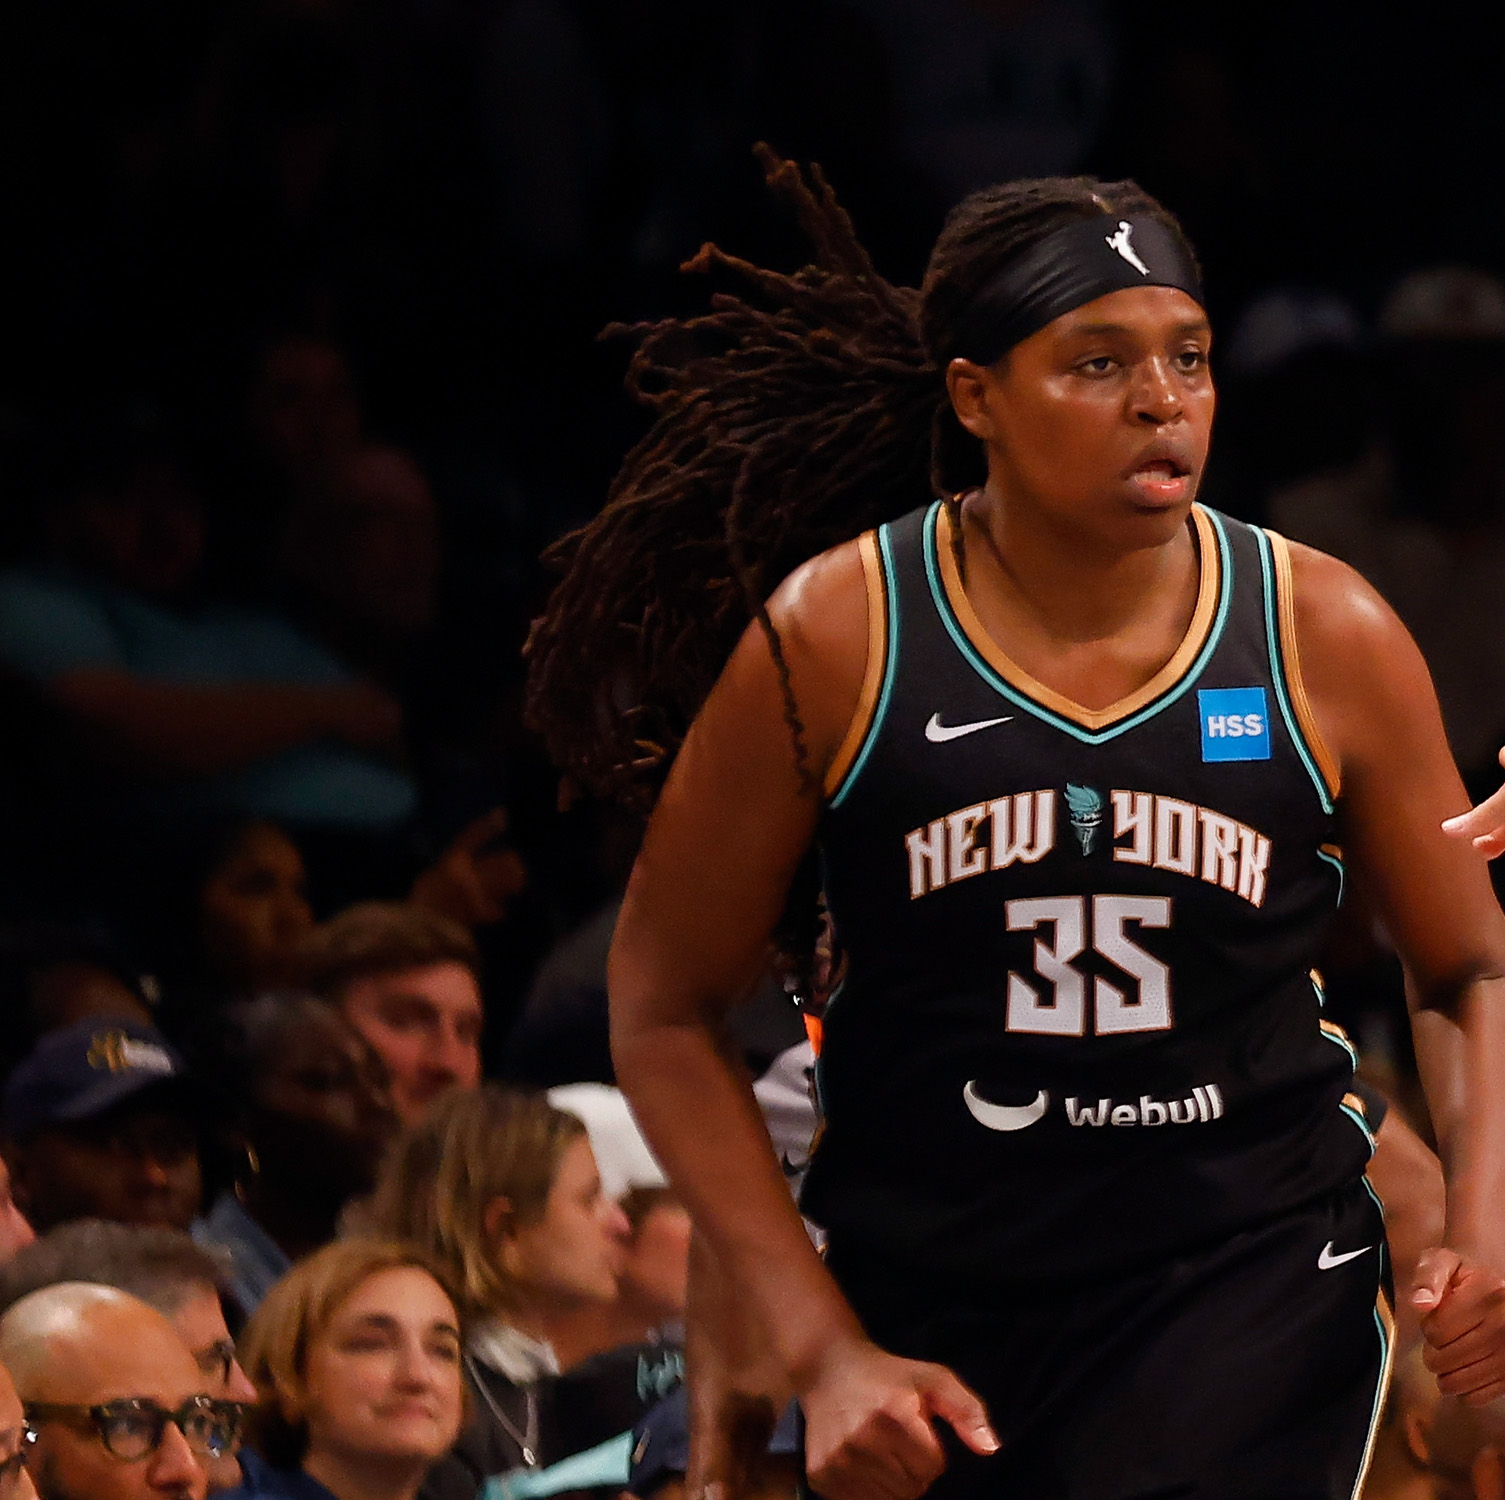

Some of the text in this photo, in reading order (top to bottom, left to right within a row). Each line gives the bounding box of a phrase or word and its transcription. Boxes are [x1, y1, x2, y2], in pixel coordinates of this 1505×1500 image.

[1207, 713, 1264, 738] HSS
[904, 788, 1272, 908] NEW YORK
[1004, 893, 1173, 1037] 35
[1065, 1084, 1225, 1128] Webull
